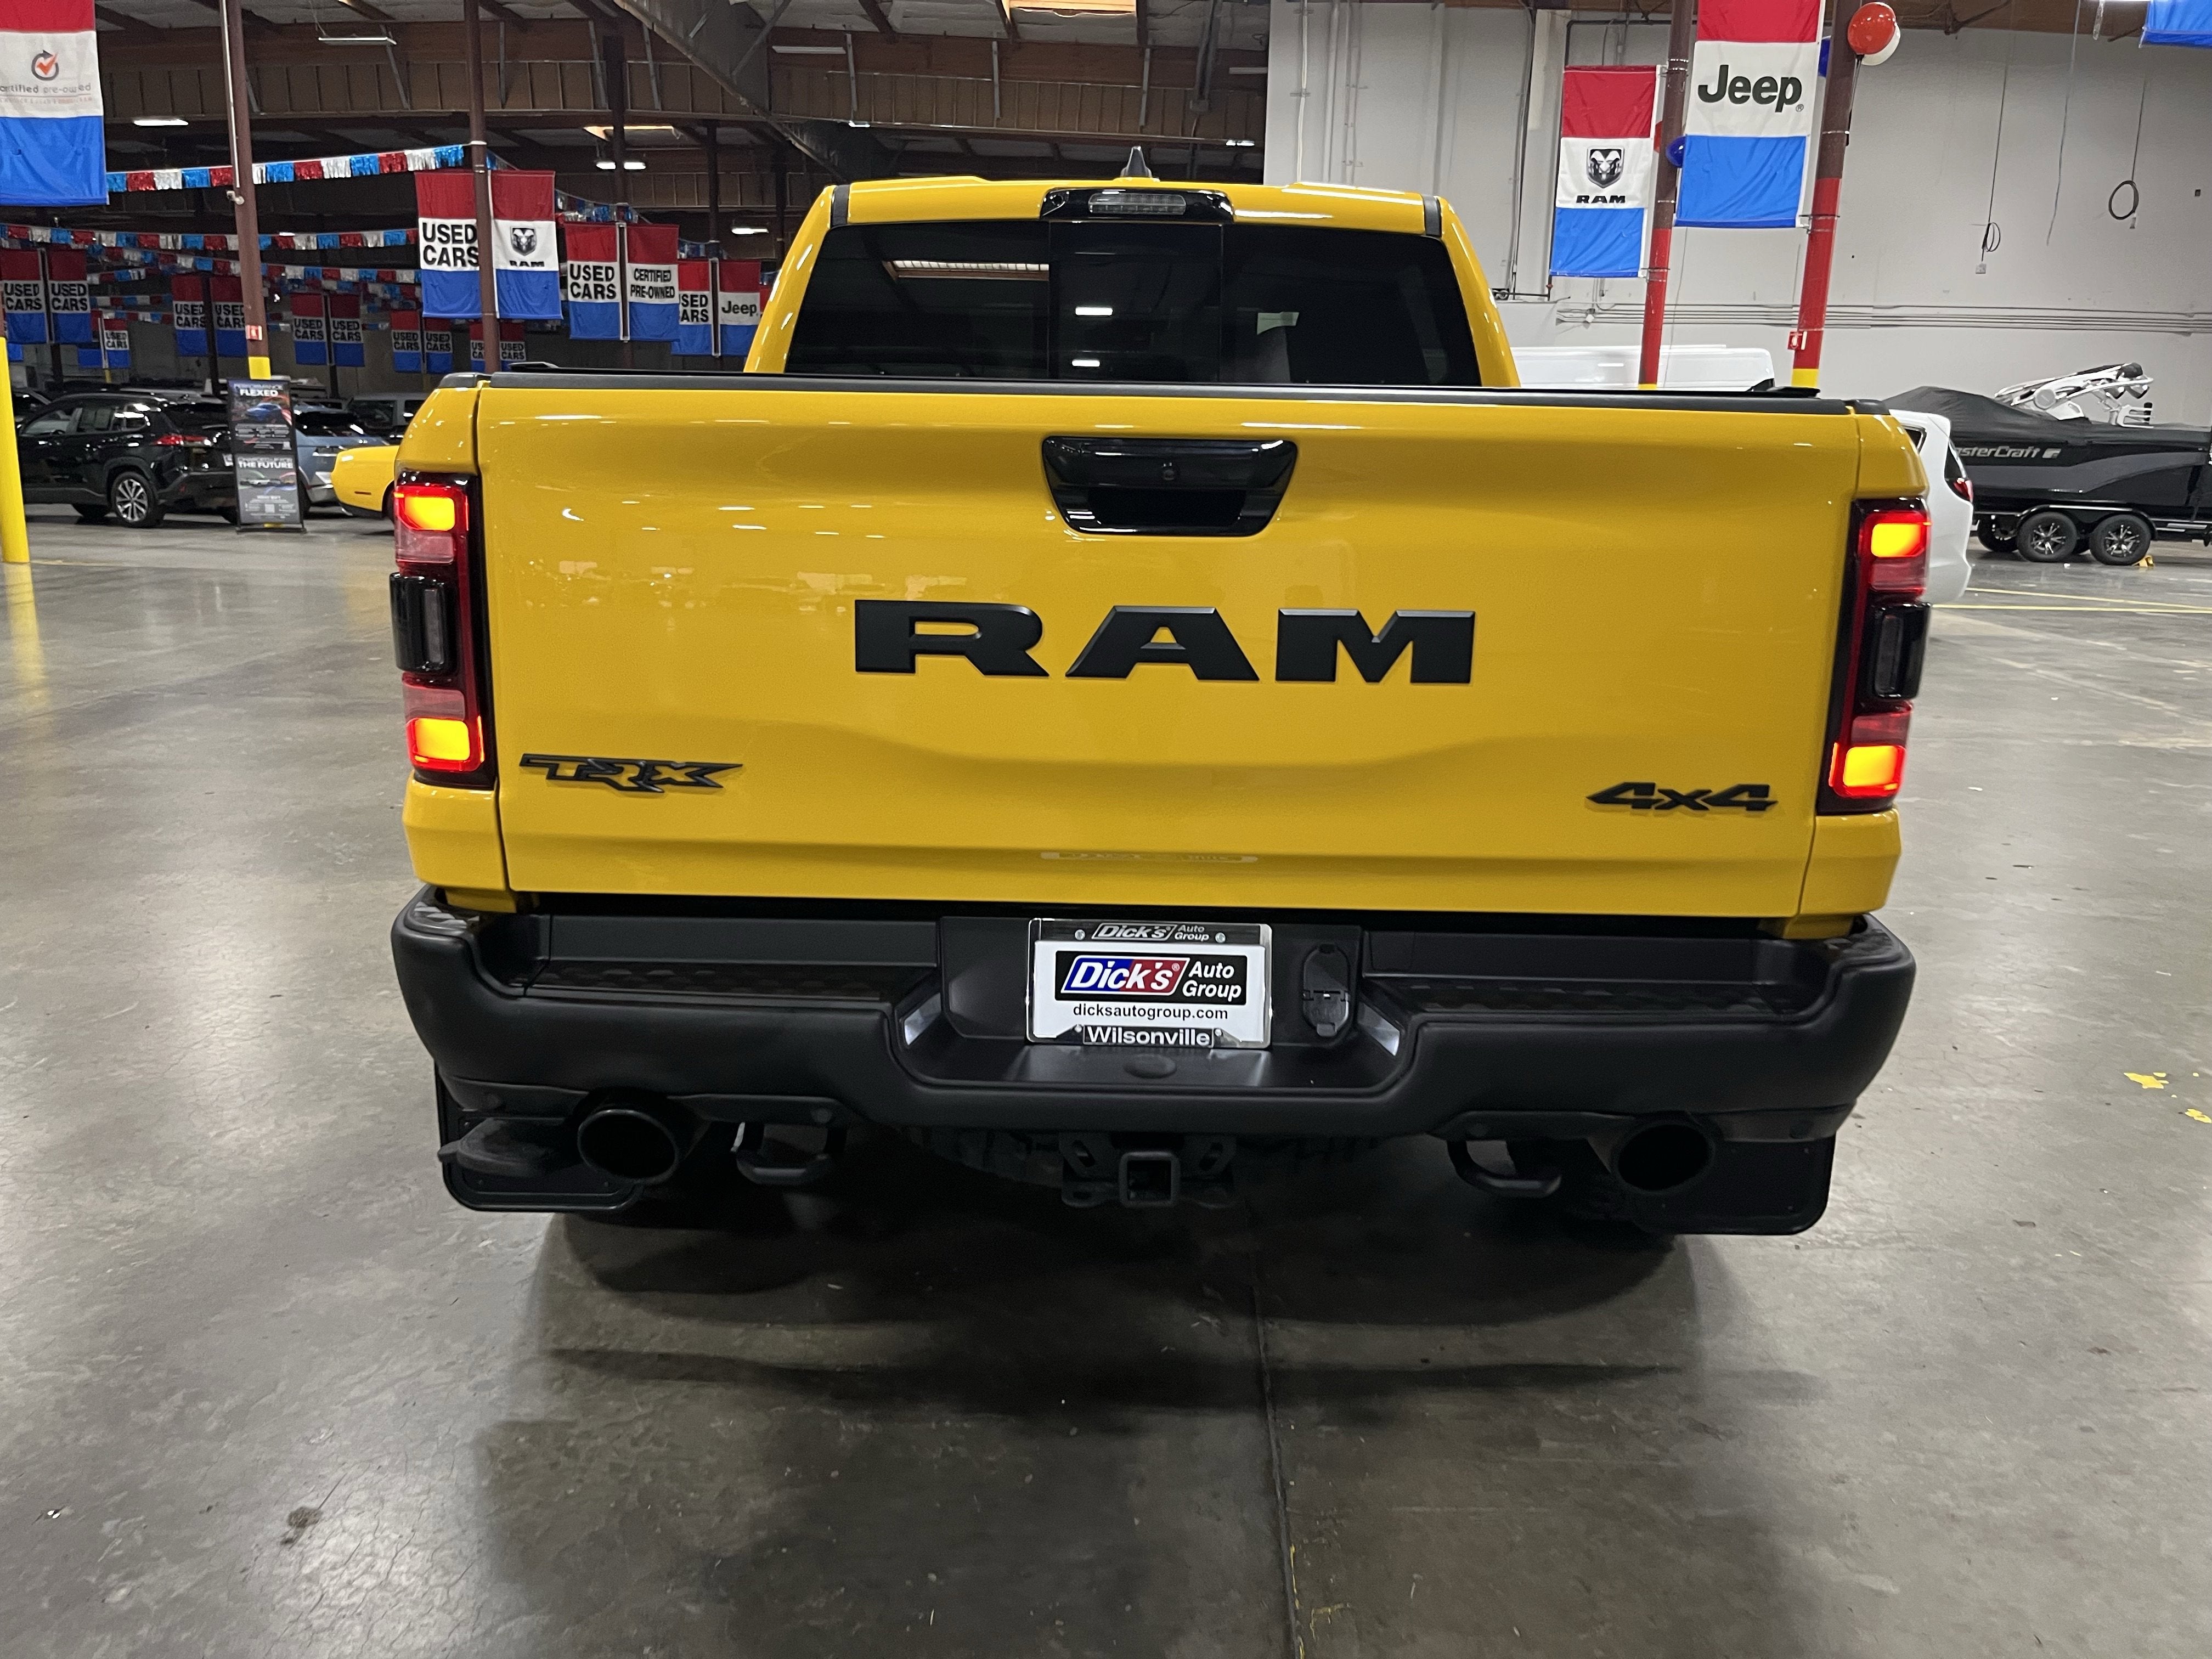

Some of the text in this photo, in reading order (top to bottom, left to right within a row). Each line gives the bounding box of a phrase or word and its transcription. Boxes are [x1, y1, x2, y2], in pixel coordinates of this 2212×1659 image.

[1697, 64, 1802, 112] Jeep
[1576, 195, 1626, 204] RAM
[422, 222, 477, 244] USED
[423, 245, 479, 267] CARS
[570, 264, 614, 281] USED
[634, 268, 672, 282] CERTIFIED
[4, 283, 40, 296] USED
[51, 283, 87, 296] USED
[570, 282, 617, 300] CARS
[631, 284, 675, 298] PRE-OWNED
[5, 297, 42, 311] CARS
[52, 297, 88, 311] CARS
[679, 294, 708, 307] SED
[681, 309, 709, 322] ARS
[721, 301, 757, 317] Jeep
[294, 318, 322, 328] USED
[332, 320, 360, 330] USED
[295, 330, 324, 340] CARS
[332, 331, 361, 341] CARS
[393, 332, 418, 341] USED
[426, 332, 450, 342] USED
[394, 342, 420, 351] CARS
[426, 342, 451, 352] CARS
[1955, 445, 2041, 458] asterCraft
[855, 599, 1475, 685] RAM
[519, 753, 743, 793] TRX
[1586, 781, 1779, 811] 4x4
[1098, 925, 1166, 938] Dick's
[1178, 924, 1205, 933] Auto
[1175, 932, 1209, 941] Group
[1074, 960, 1173, 991] Dick's
[1188, 961, 1234, 979] Auto
[1182, 980, 1242, 1001] Group
[1073, 1003, 1228, 1020] dicksautogroup.com
[1086, 1025, 1210, 1046] Wilsonville
